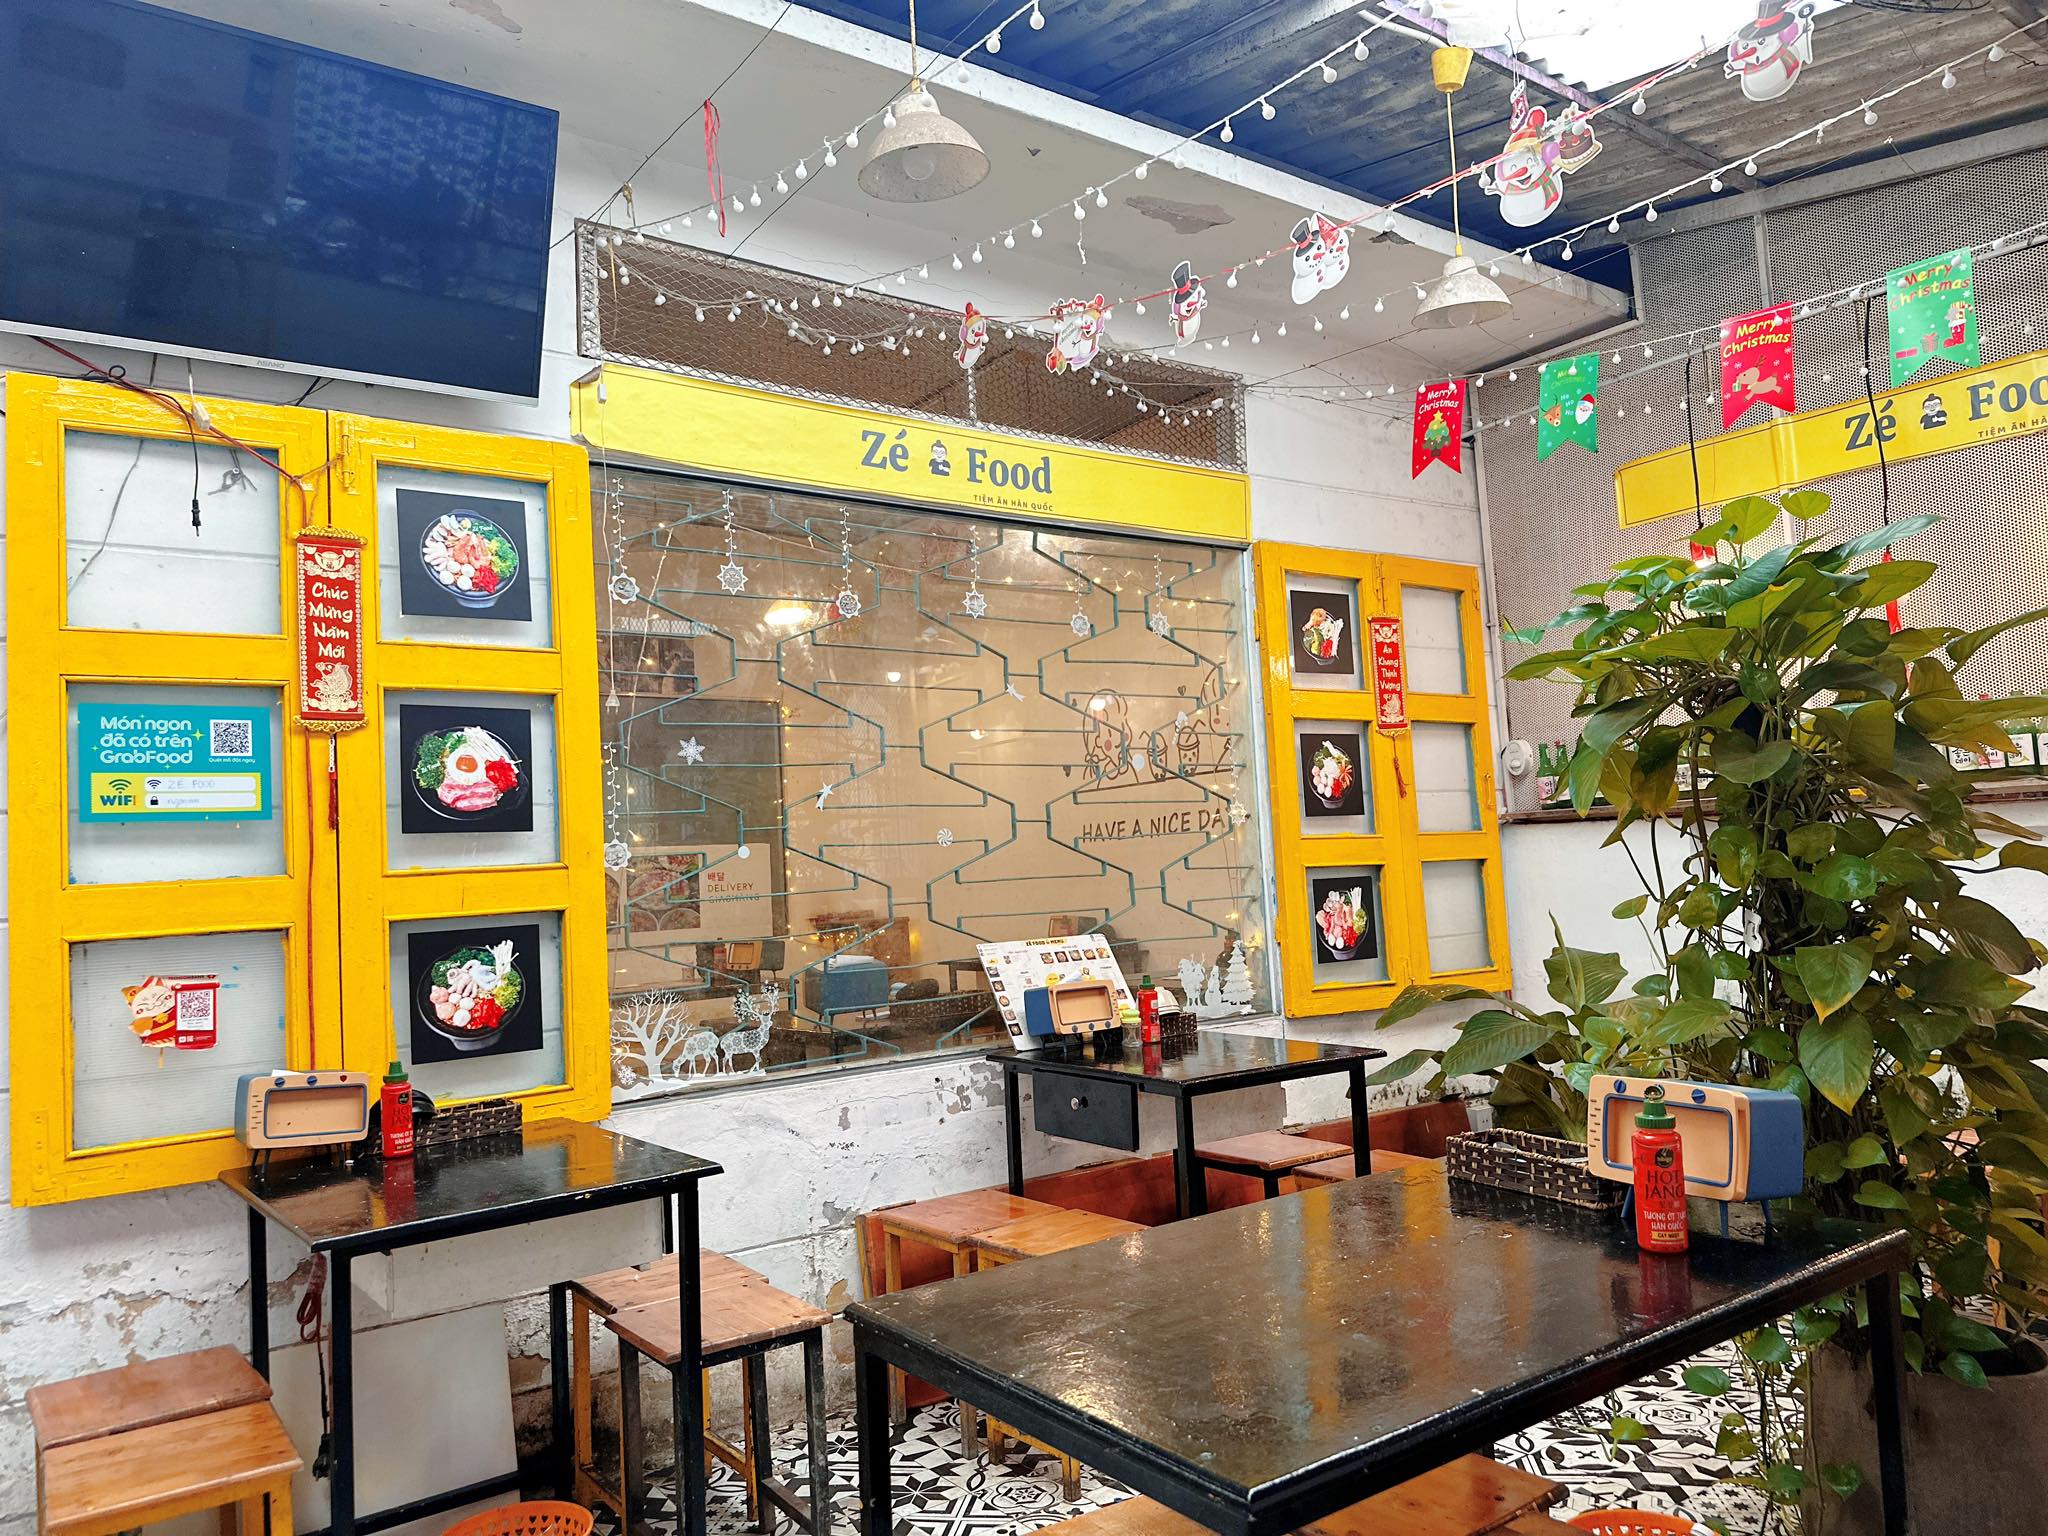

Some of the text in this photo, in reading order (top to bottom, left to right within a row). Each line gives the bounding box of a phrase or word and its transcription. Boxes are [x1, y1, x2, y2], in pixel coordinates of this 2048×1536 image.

[1904, 263, 1952, 286] Merry
[1889, 278, 1971, 312] Christmas
[1736, 319, 1775, 339] Merry
[1723, 333, 1791, 359] Christmas
[1427, 389, 1454, 401] Merry
[1418, 399, 1459, 415] Christmas
[1845, 399, 1897, 452] Zé
[1978, 427, 2006, 438] TIỆM
[861, 428, 1053, 494] Zé Food
[973, 493, 1054, 512] TIỆM ĂN HÀN QUỐC
[312, 582, 349, 600] Chúc
[308, 601, 353, 623] Mừng
[313, 621, 350, 640] Năm
[318, 641, 346, 658] Mới
[1383, 644, 1393, 654] An
[1378, 656, 1399, 668] Khang
[100, 716, 192, 734] Món ngon
[100, 733, 193, 748] đã có trên
[100, 749, 193, 764] GrabFood
[1082, 820, 1126, 843] HAVE
[1132, 819, 1144, 838] A
[1150, 811, 1192, 838] NICE
[707, 881, 754, 893] DELIVERY
[1647, 1170, 1681, 1184] HOT
